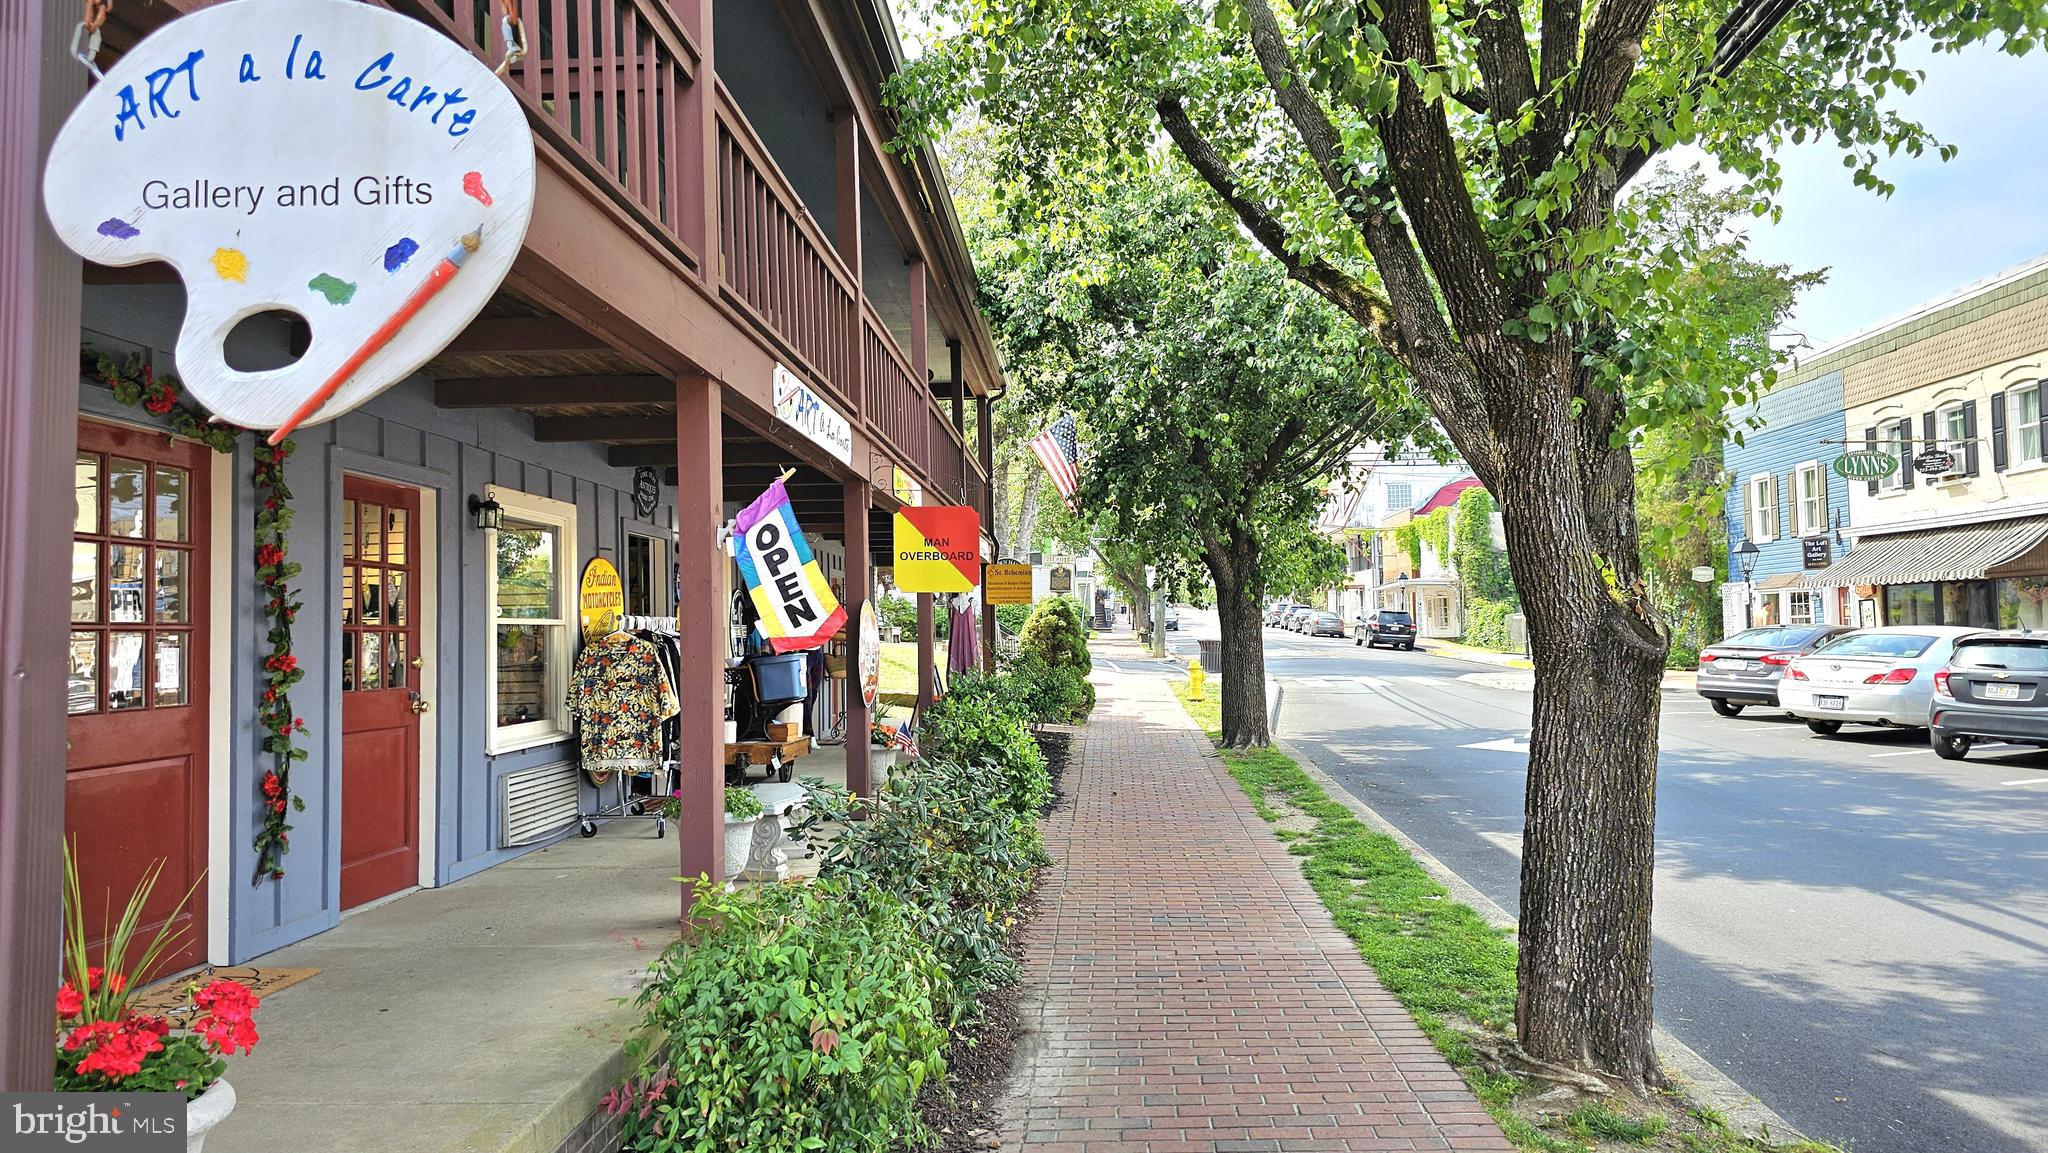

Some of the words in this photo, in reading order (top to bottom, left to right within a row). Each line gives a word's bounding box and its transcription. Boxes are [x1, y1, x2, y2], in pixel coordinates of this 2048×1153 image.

[115, 48, 205, 141] ART
[239, 53, 261, 84] a
[286, 34, 326, 79] la
[355, 52, 477, 137] Carte
[142, 179, 265, 215] Gallery
[276, 177, 339, 207] and
[353, 175, 433, 206] Gifts
[796, 388, 819, 436] ART
[1844, 456, 1888, 476] LYNNS
[924, 538, 950, 547] MAN
[900, 551, 974, 561] OVERBOARD
[586, 565, 616, 588] Indian
[756, 523, 817, 628] OPEN
[582, 592, 621, 609] MOTORCYCLES
